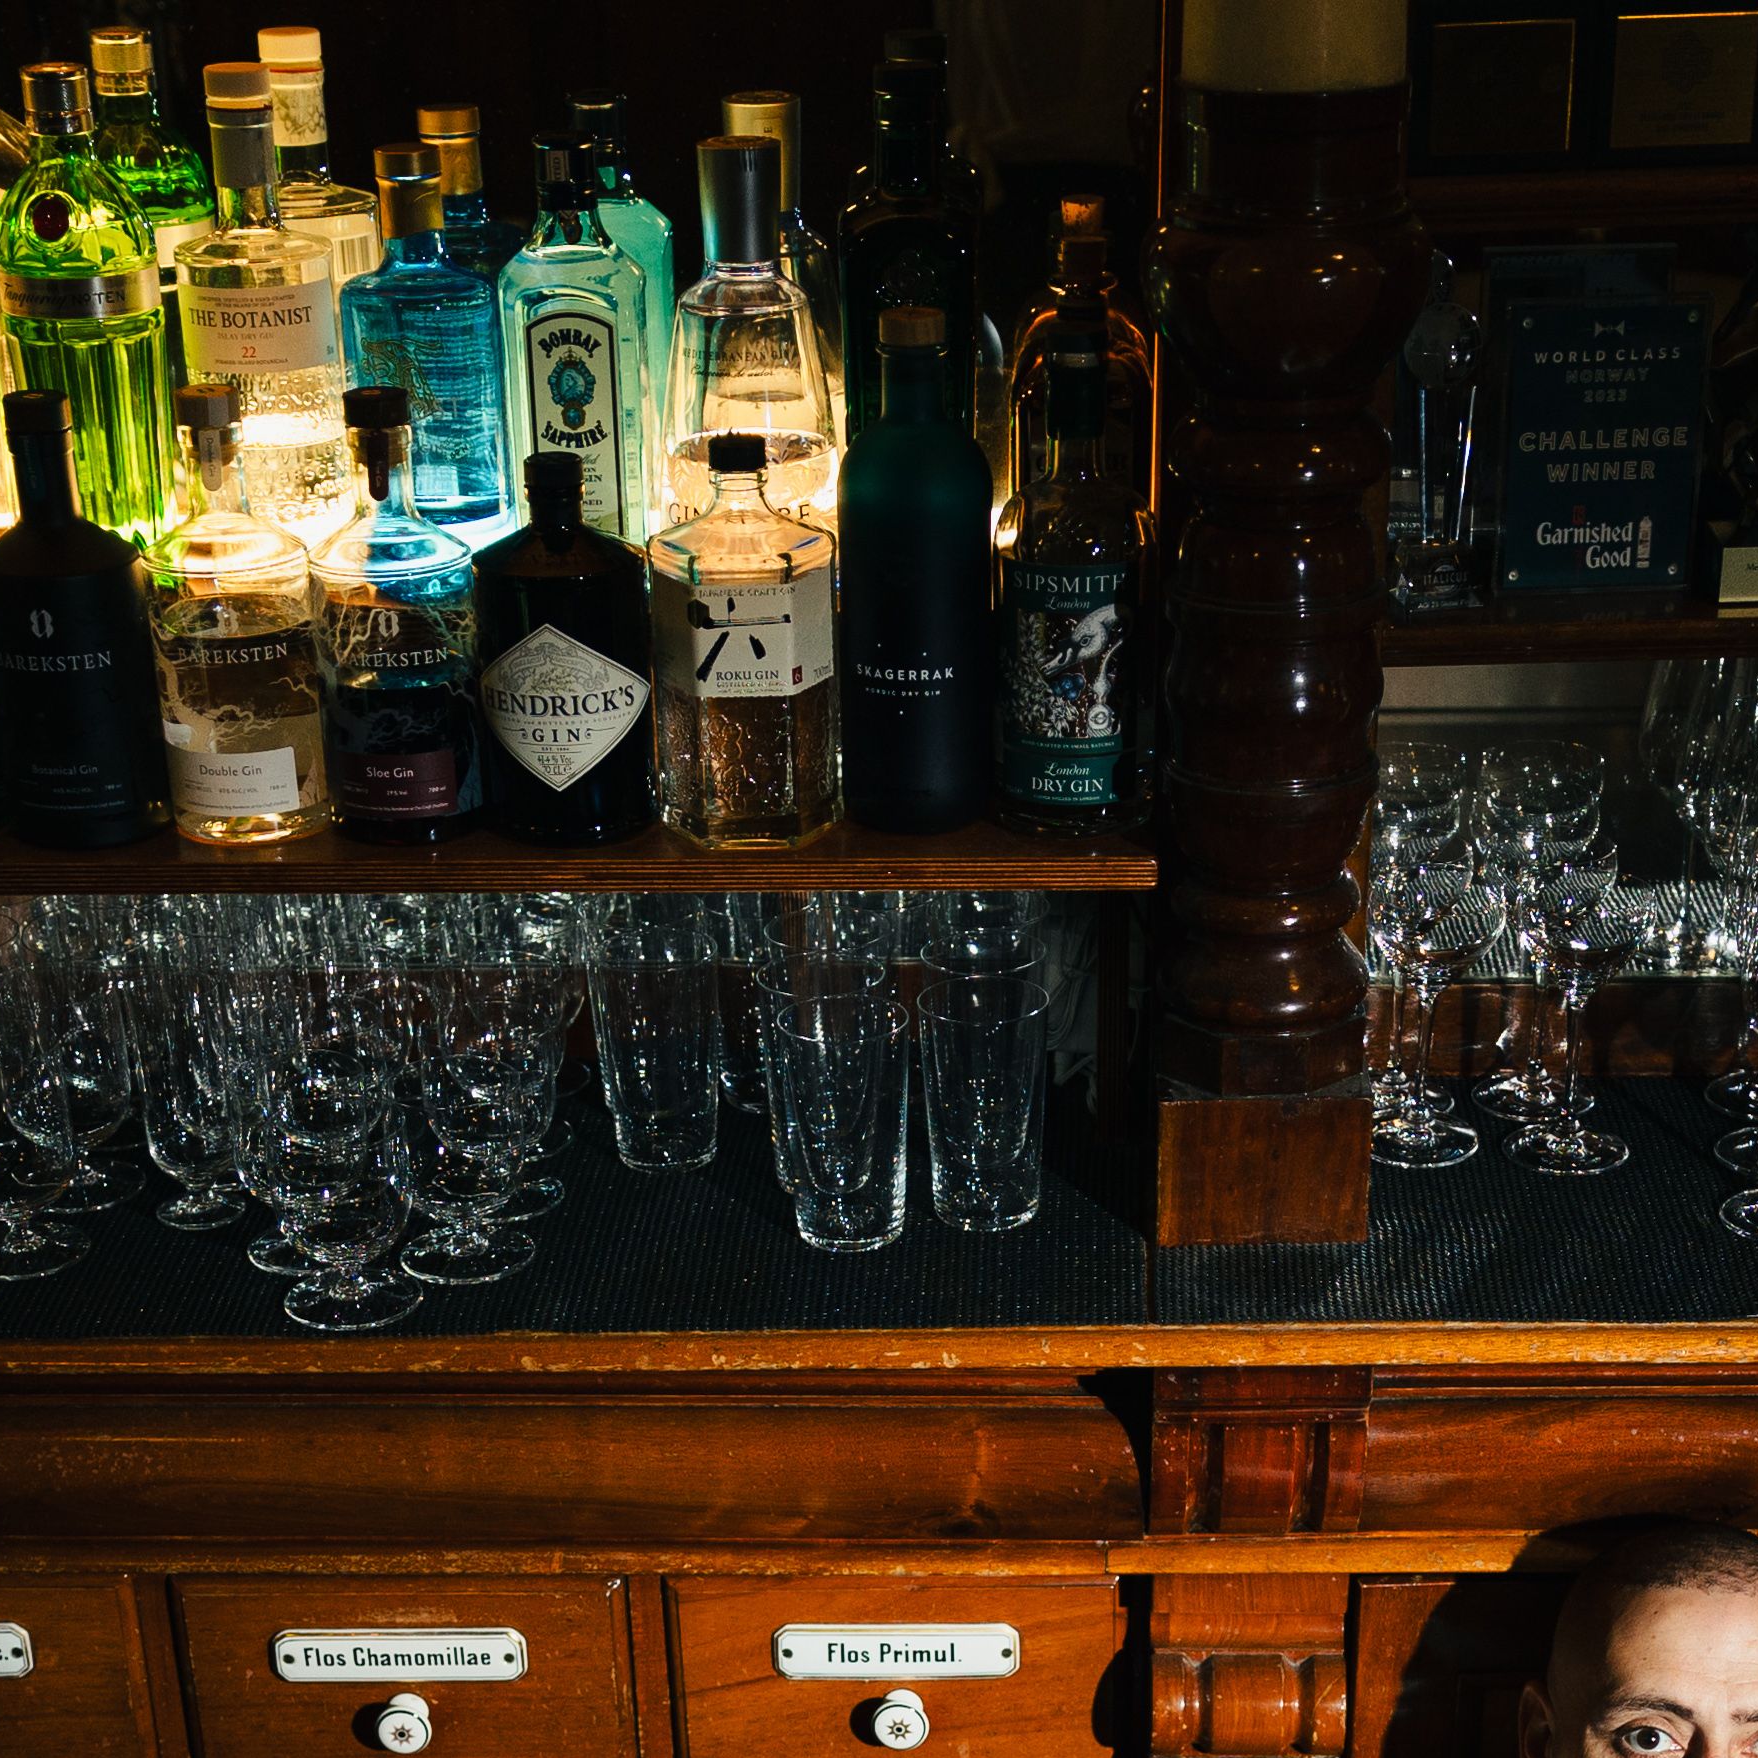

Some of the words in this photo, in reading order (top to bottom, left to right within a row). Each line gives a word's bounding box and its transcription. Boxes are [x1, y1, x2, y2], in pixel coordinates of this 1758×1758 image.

[189, 307, 218, 327] THE
[221, 305, 312, 328] BOTANIST
[242, 346, 257, 358] 22
[537, 328, 602, 358] BOMBAY
[1534, 348, 1612, 365] WORLD
[1616, 346, 1681, 362] CLASS
[1565, 367, 1650, 386] NORWAY
[1583, 387, 1629, 404] 2023
[540, 420, 608, 448] SAPPHIRE
[1518, 426, 1689, 453] CHALLENGE
[1546, 459, 1657, 484] WINNER
[1535, 520, 1634, 547] Garnished
[1585, 546, 1633, 571] Good
[1012, 569, 1127, 592] SIPSMITH
[1423, 570, 1468, 587] ITALICUS
[1045, 595, 1092, 611] London
[178, 642, 289, 666] BAREKSTEN
[716, 670, 753, 682] ROKU
[754, 669, 779, 680] GIN
[855, 662, 955, 682] SKAGERRAK
[483, 684, 636, 717] HENDRICK'S
[901, 688, 920, 697] DRY
[924, 689, 942, 697] GIN
[531, 727, 581, 743] GIN
[31, 763, 77, 777] Botanical
[79, 764, 99, 775] Gin
[199, 764, 239, 778] Double
[241, 765, 263, 777] Gin
[365, 766, 391, 779] Sloe
[393, 767, 415, 779] Gin
[1044, 760, 1091, 777] London
[1031, 776, 1067, 793] DRY
[1070, 778, 1104, 793] GIN
[303, 1647, 347, 1667] Flos
[352, 1647, 492, 1667] Chamomillae
[826, 1642, 871, 1664] Flos
[878, 1642, 963, 1664] Primul.
